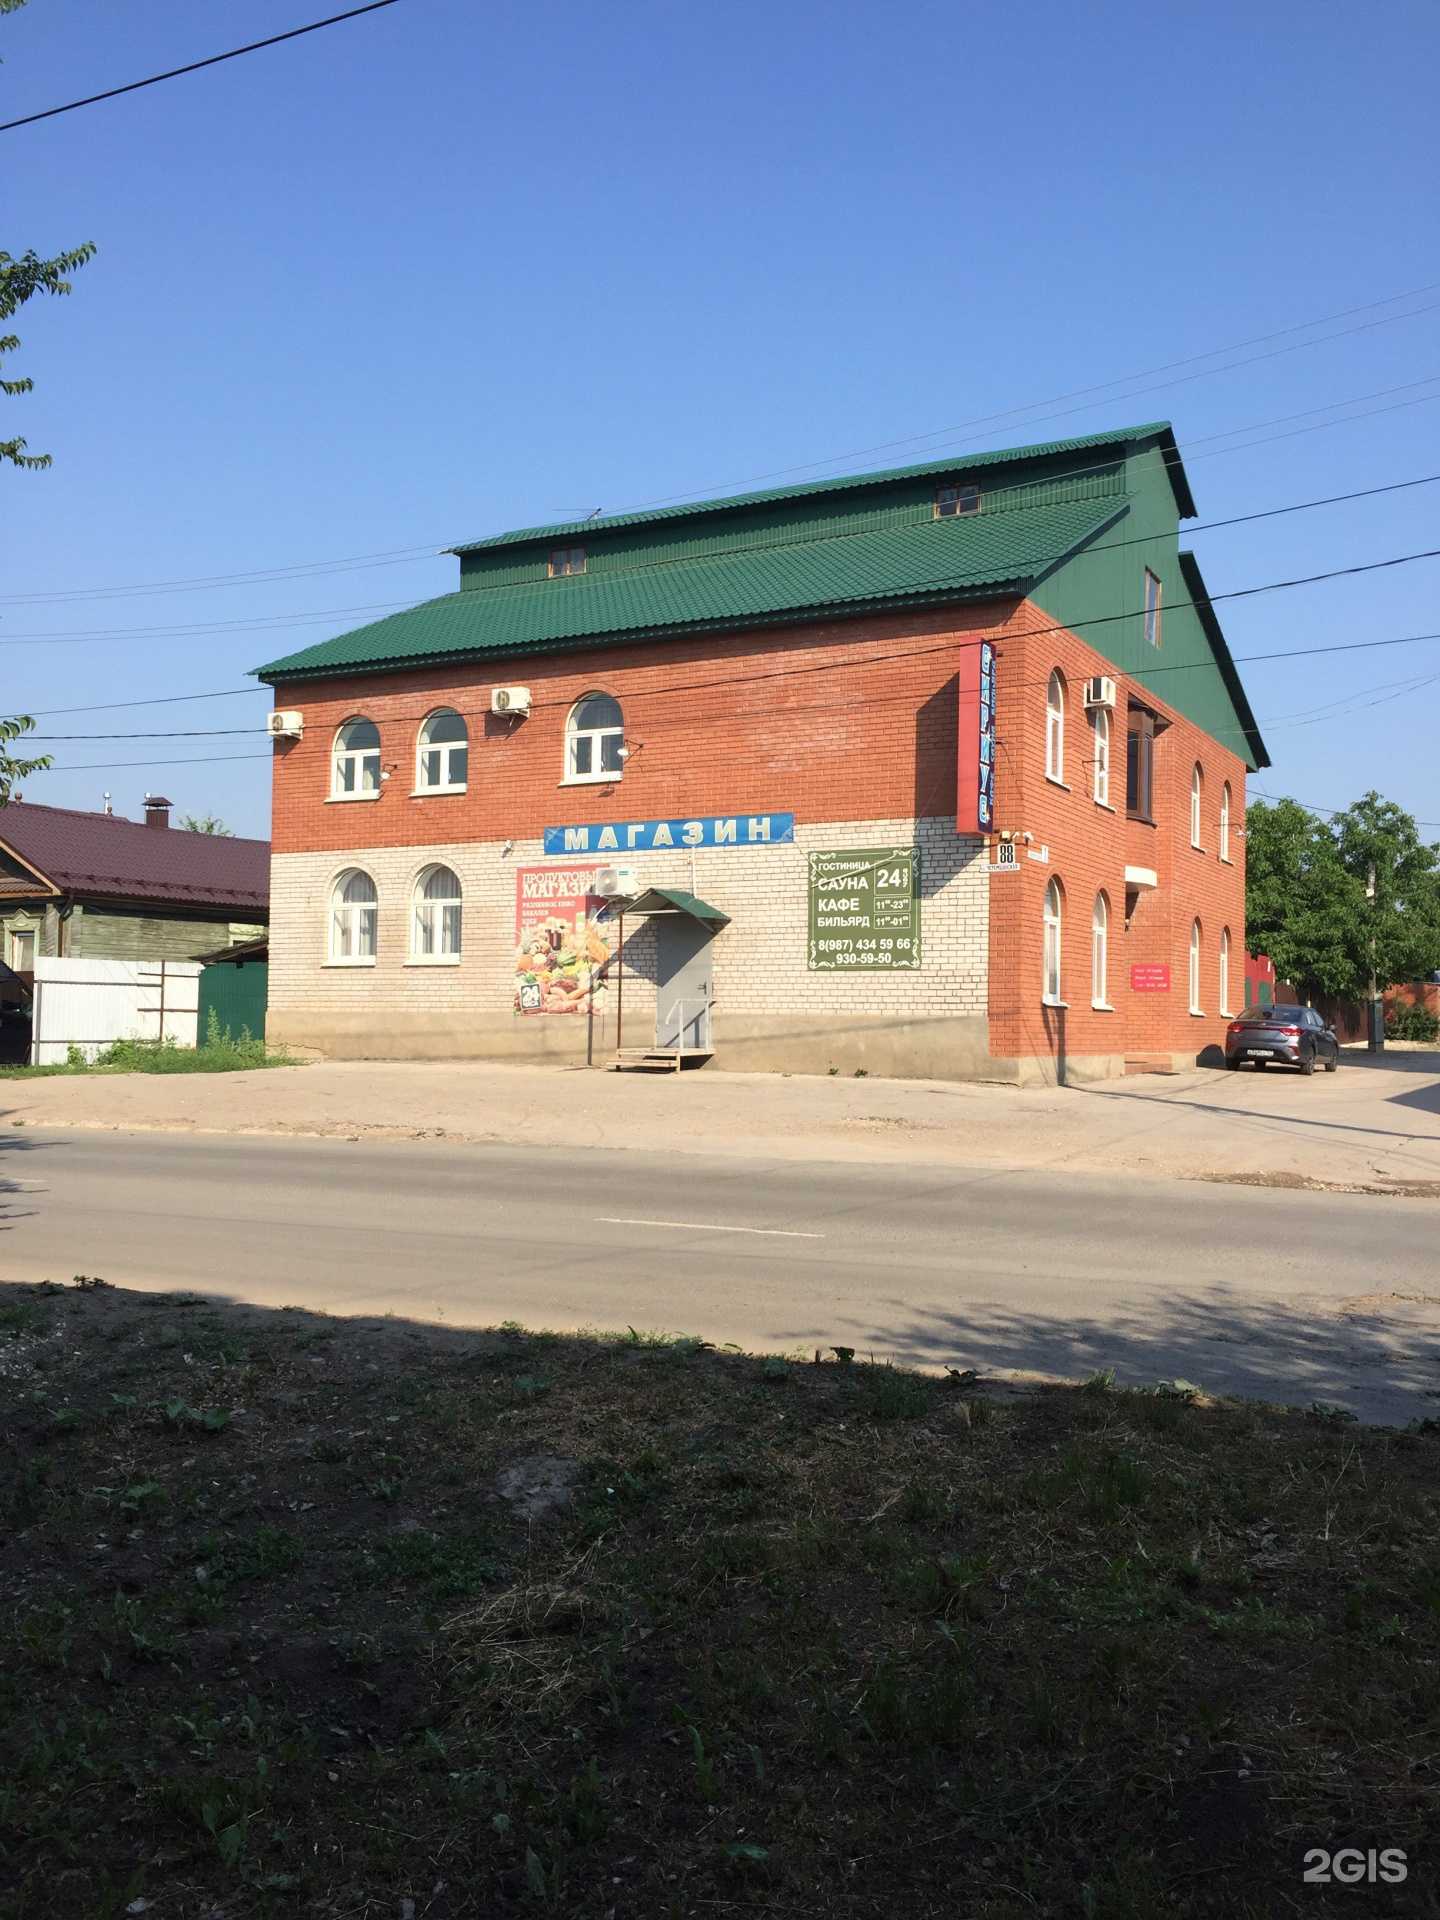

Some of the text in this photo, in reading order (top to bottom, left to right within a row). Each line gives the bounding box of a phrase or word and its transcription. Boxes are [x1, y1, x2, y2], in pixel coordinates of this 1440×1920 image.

[564, 816, 771, 851] МАГАЗИН
[999, 844, 1014, 864] 88
[818, 861, 871, 871] ГОСТИНИЦА
[522, 871, 596, 884] ПРОДУКТОВЫ
[818, 876, 869, 891] САУНА
[876, 868, 902, 888] 24
[522, 882, 591, 898] МАГАЗИ
[818, 898, 860, 911] КАФЕ
[817, 916, 870, 928] БИЛЬЯРД
[818, 938, 911, 952] 8(987) 434 59 66
[836, 953, 892, 964] 930-59-50
